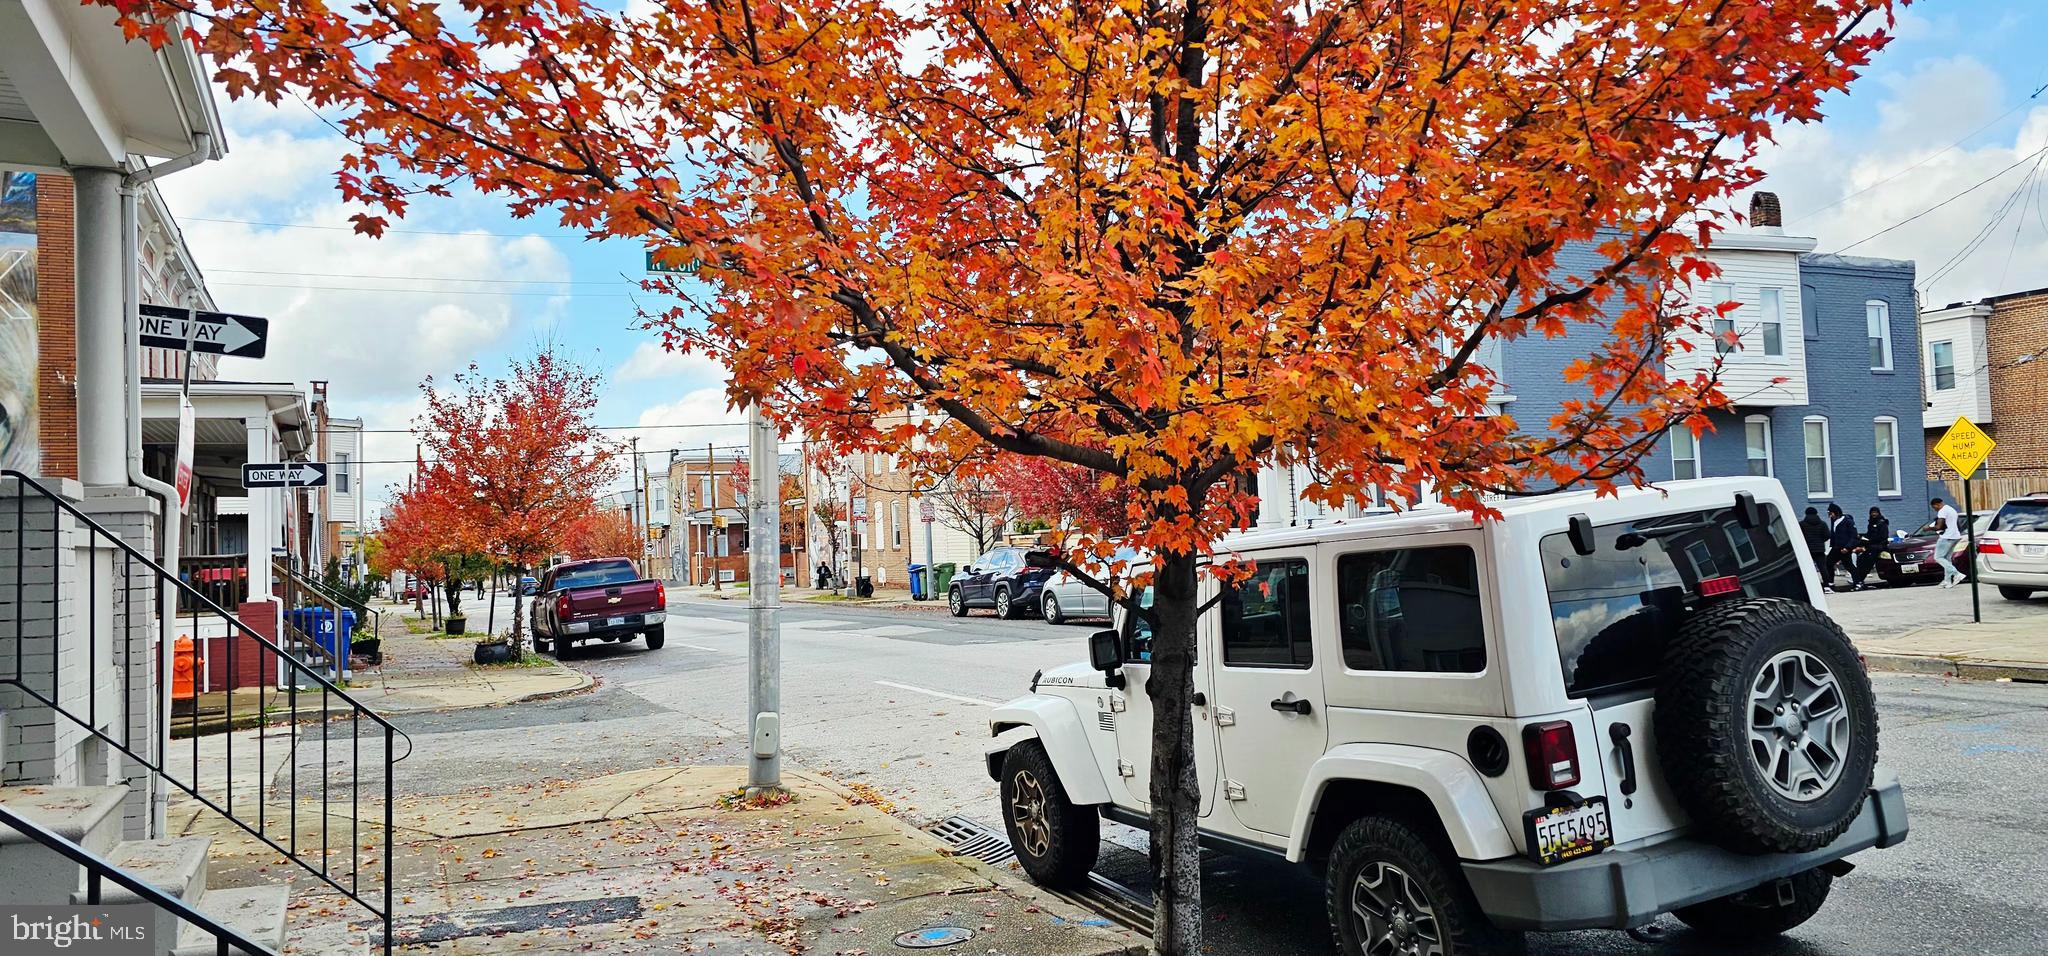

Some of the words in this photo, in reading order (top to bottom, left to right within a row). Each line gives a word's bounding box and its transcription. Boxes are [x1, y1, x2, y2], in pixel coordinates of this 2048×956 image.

[181, 321, 222, 341] WAY
[1951, 431, 1976, 441] SPEED
[1952, 442, 1976, 450] HUMP
[1951, 451, 1979, 460] AHEAD
[252, 471, 275, 481] ONE
[279, 470, 302, 480] WAY
